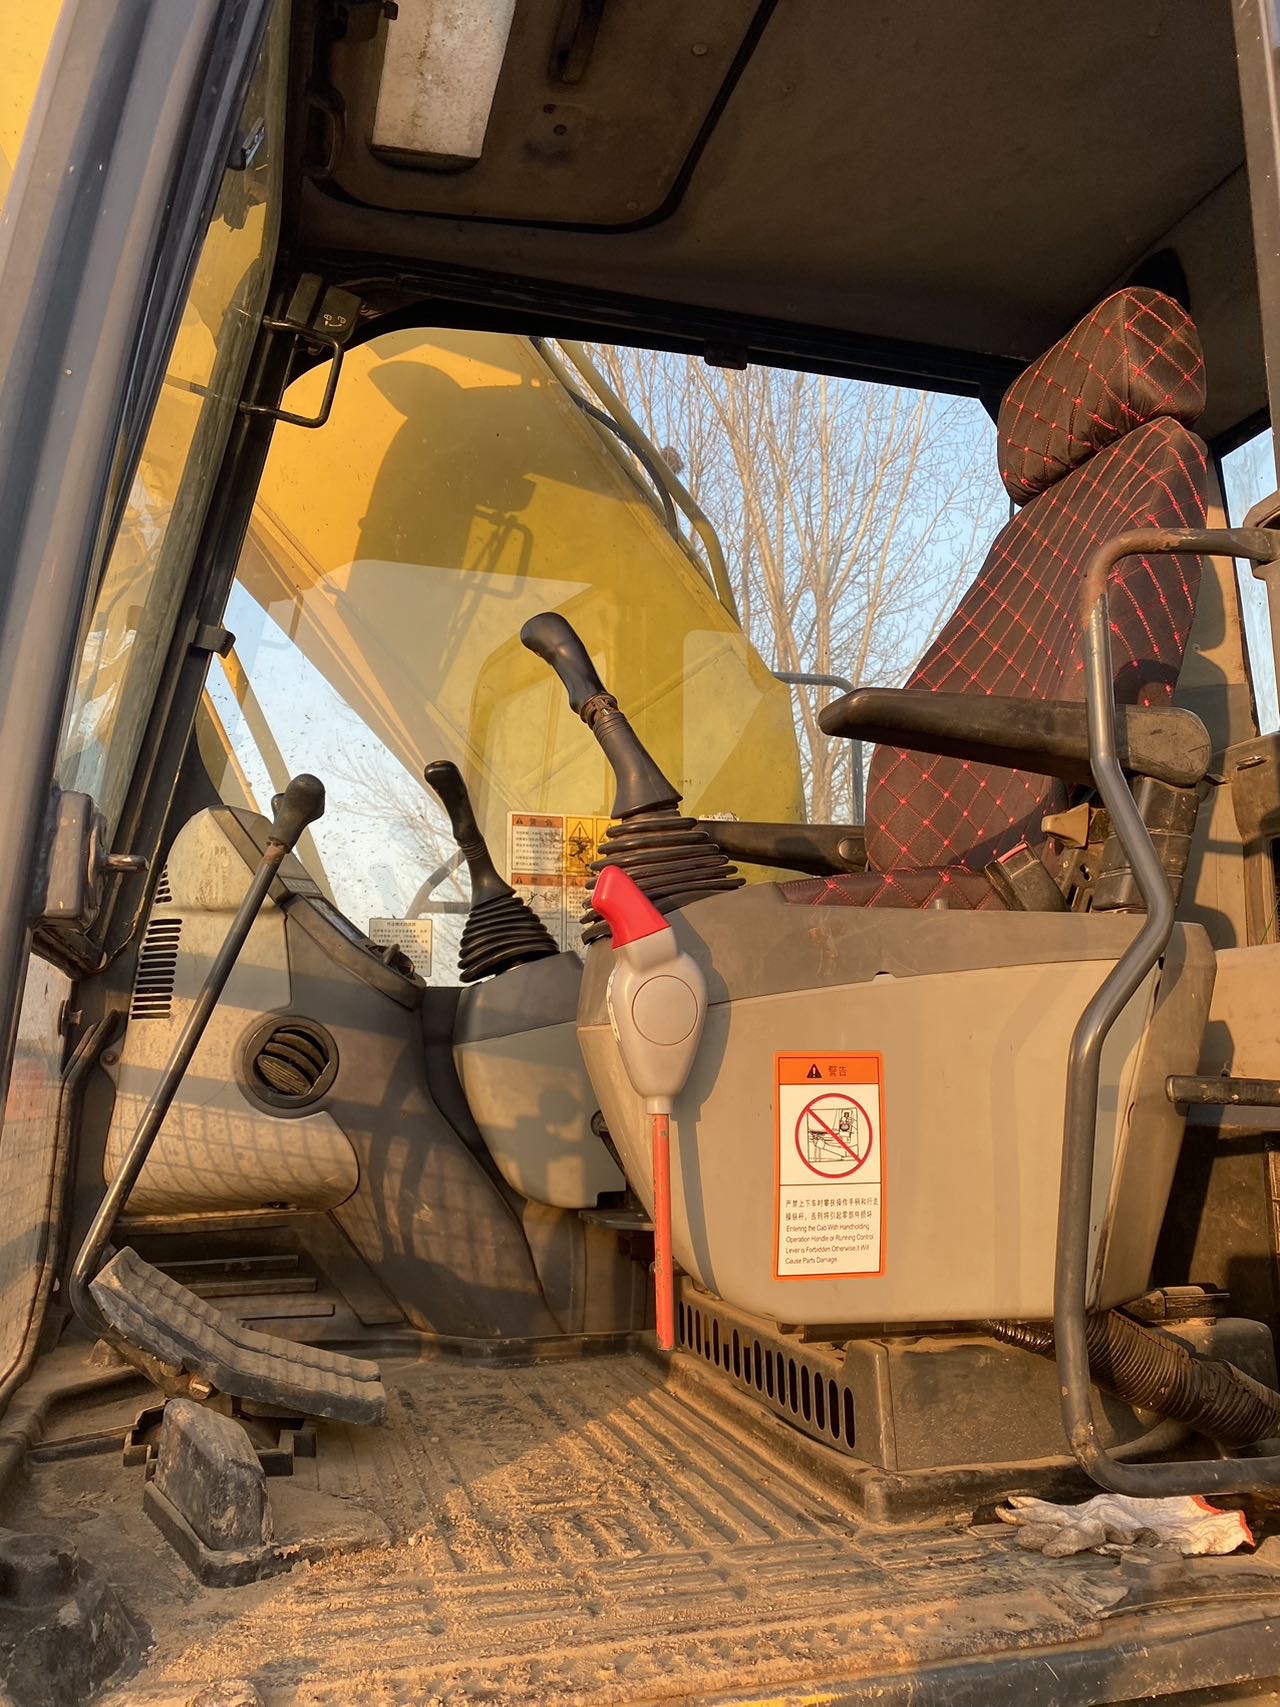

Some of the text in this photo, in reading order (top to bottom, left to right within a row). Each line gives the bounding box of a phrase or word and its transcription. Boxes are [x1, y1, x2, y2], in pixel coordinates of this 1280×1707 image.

[828, 1065, 847, 1077] 警告
[786, 1225, 807, 1233] Entering
[839, 1223, 870, 1231] Handholding
[835, 1234, 856, 1242] Running
